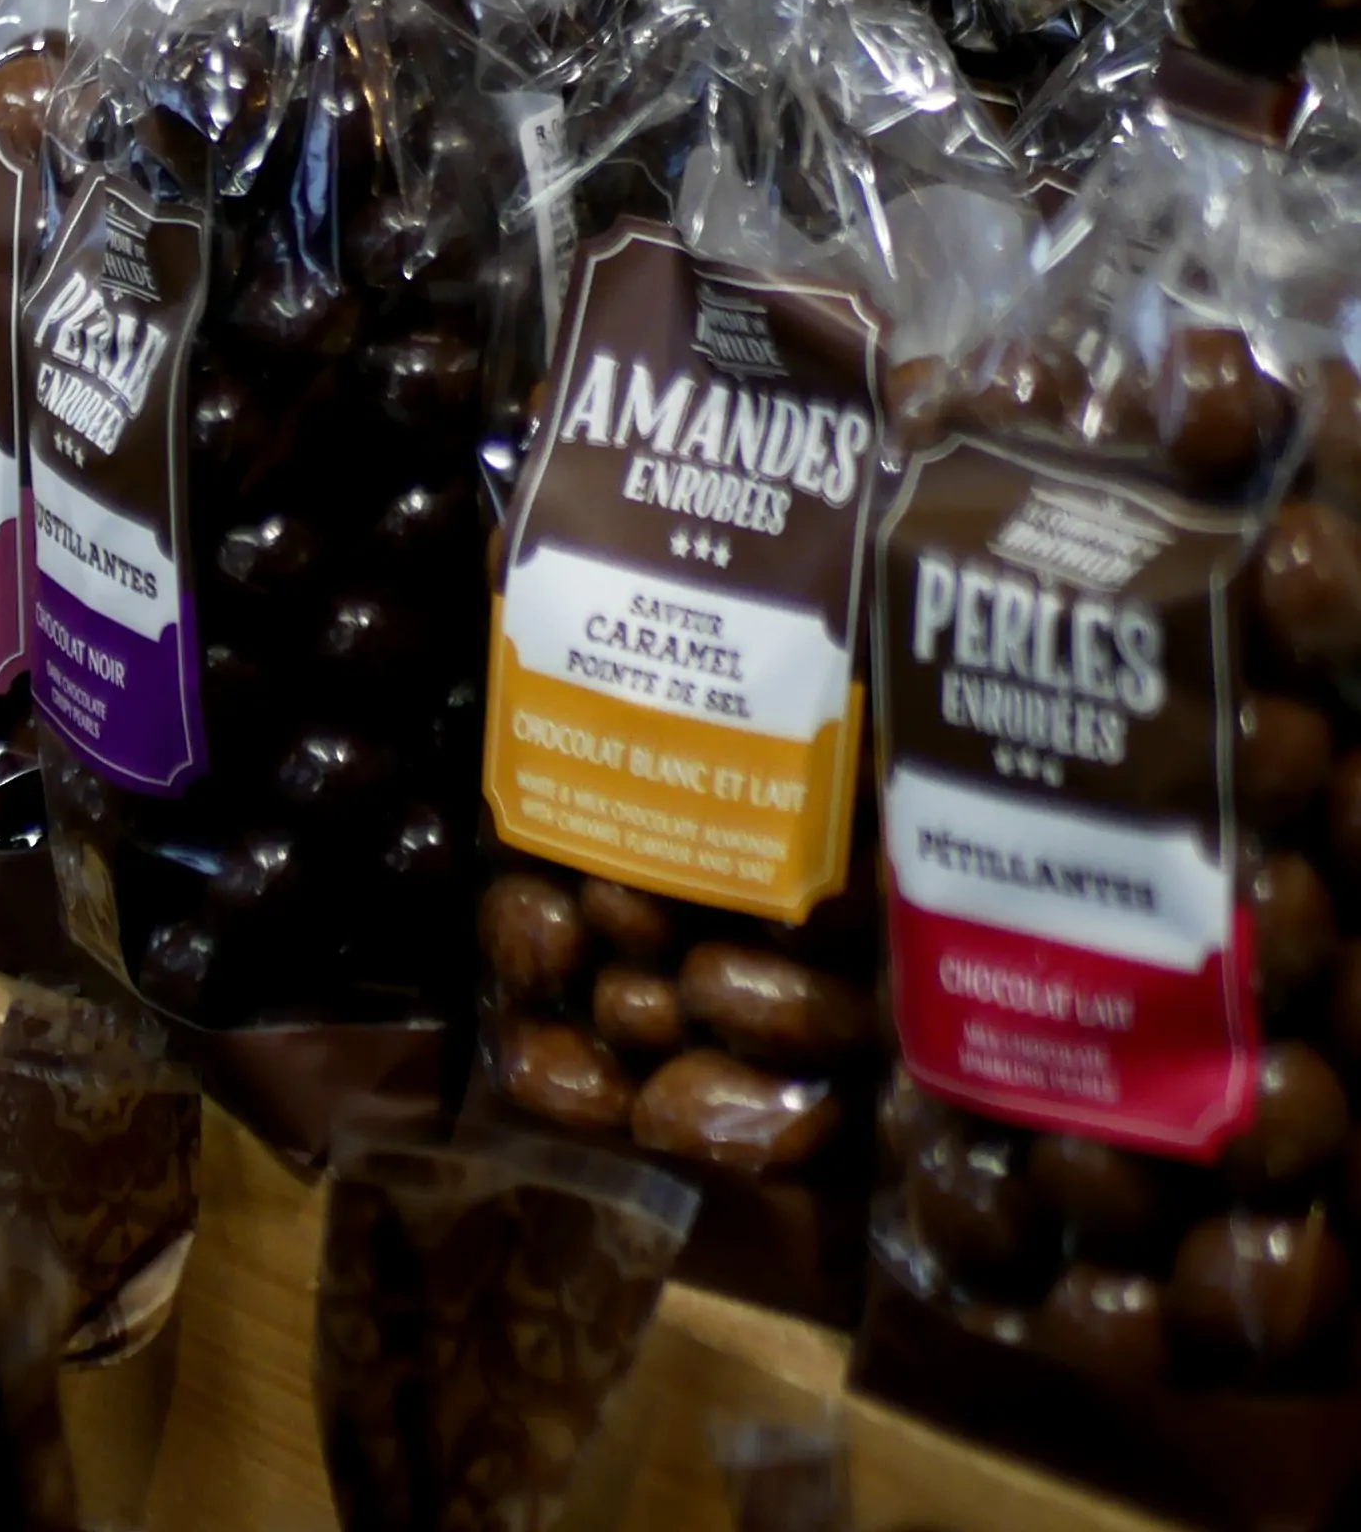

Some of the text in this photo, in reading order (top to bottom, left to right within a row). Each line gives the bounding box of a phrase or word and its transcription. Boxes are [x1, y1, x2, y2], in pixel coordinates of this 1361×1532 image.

[560, 353, 872, 510] AMANDES
[622, 456, 792, 536] ENROBÉES
[35, 600, 126, 690] CHOCOLAT NOIR
[585, 613, 744, 682] CARAMEL
[629, 594, 724, 638] SAVEUR
[911, 554, 1166, 716] PERLES
[566, 648, 751, 719] POINTE DE SEL
[511, 708, 809, 812] CHOCOLAT BLANC ET LAIT
[917, 824, 1156, 914] PÉTILLANTES
[938, 954, 1136, 1032] CHOCOLAT LAIT
